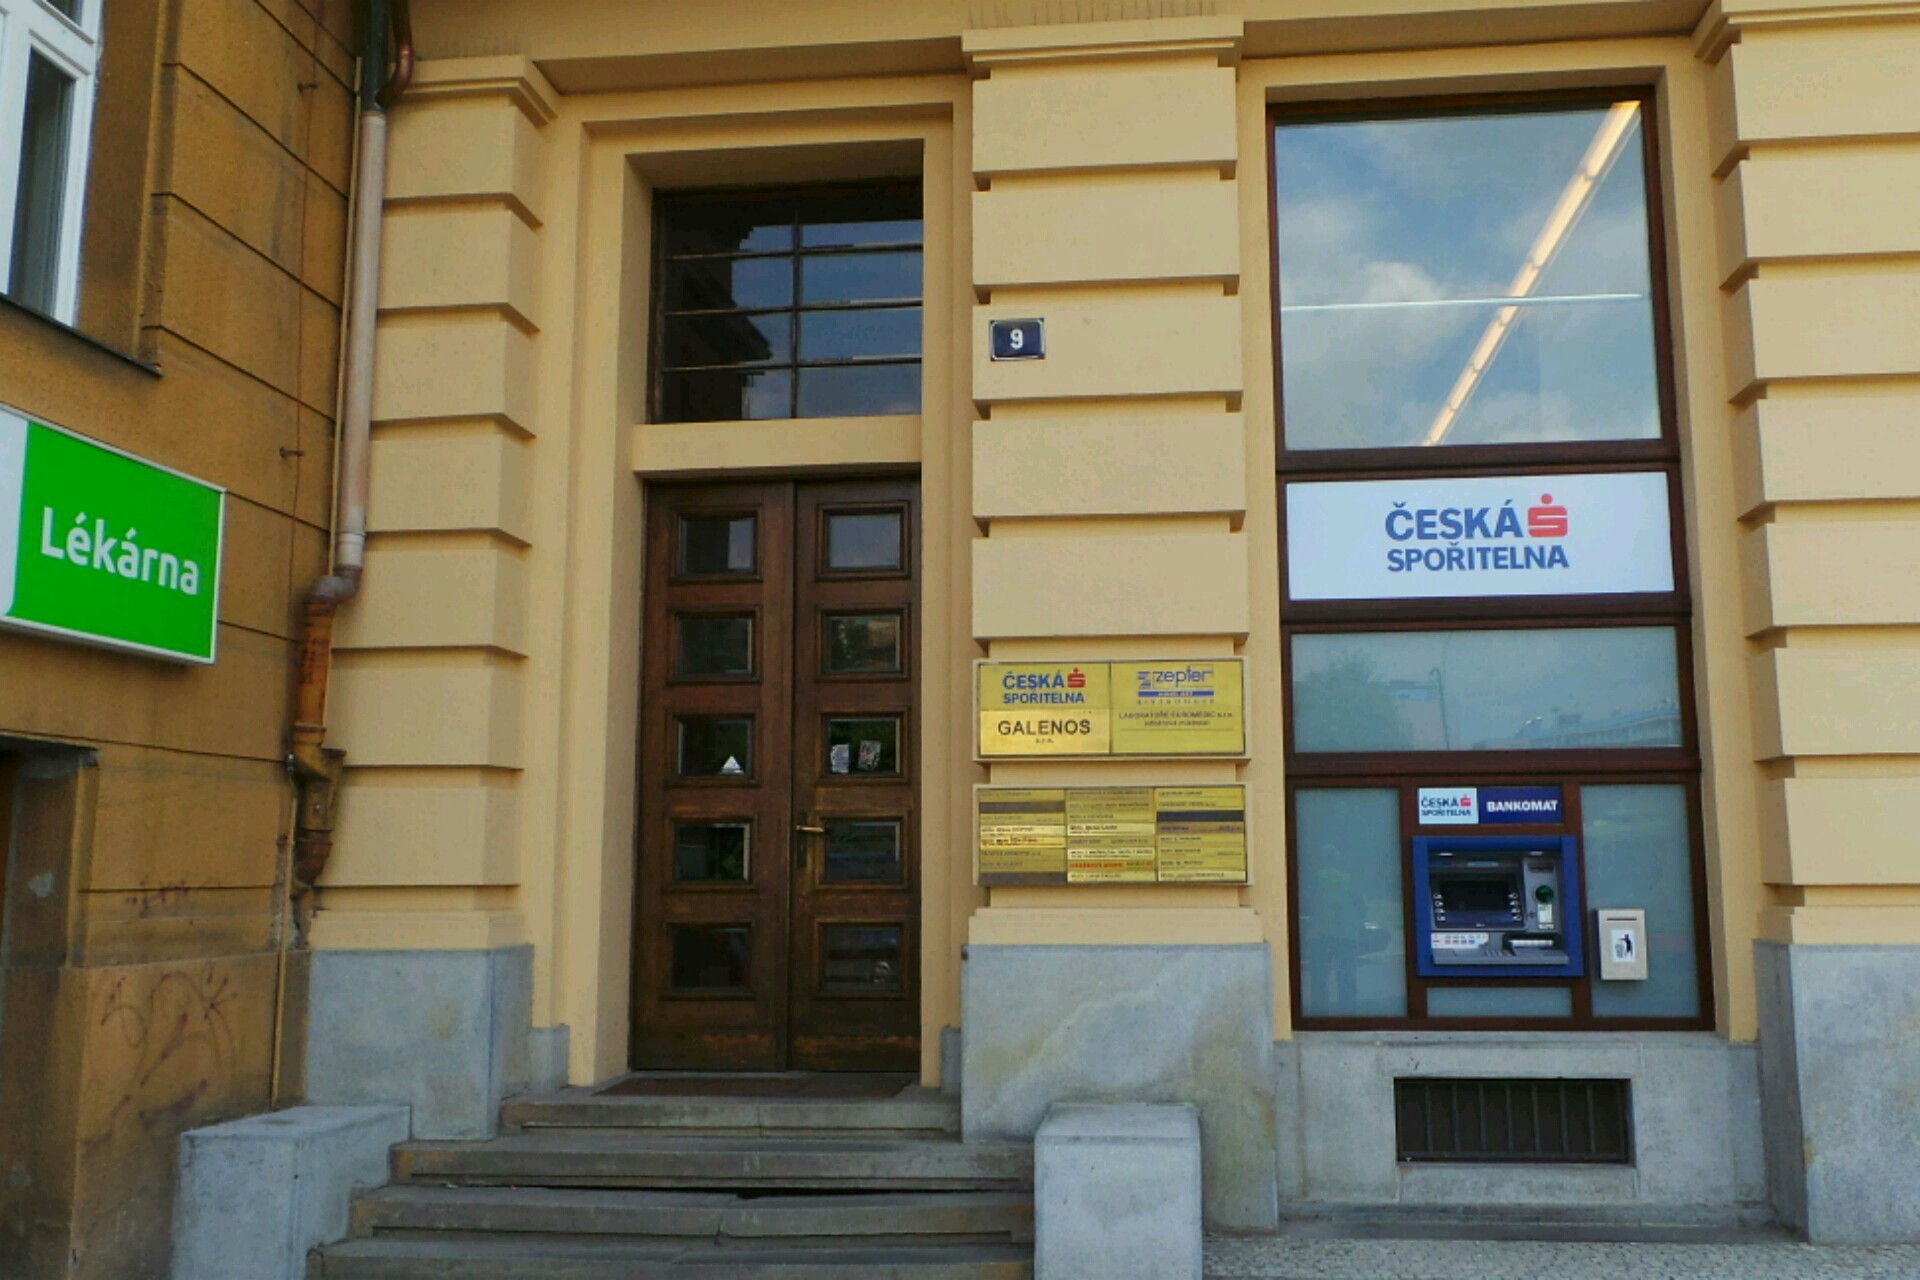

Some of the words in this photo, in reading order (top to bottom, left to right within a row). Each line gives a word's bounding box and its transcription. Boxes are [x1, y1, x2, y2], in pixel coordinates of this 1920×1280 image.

[1010, 329, 1024, 350] 9
[1385, 499, 1524, 541] ČESKÁ
[41, 506, 199, 595] Lékárna
[1387, 542, 1570, 572] SPOŘITELNA
[1003, 669, 1065, 690] ČESKÁ
[998, 718, 1091, 736] GALENOS
[1421, 796, 1459, 808] ČESKÁ
[1486, 800, 1558, 812] BANKOMAT
